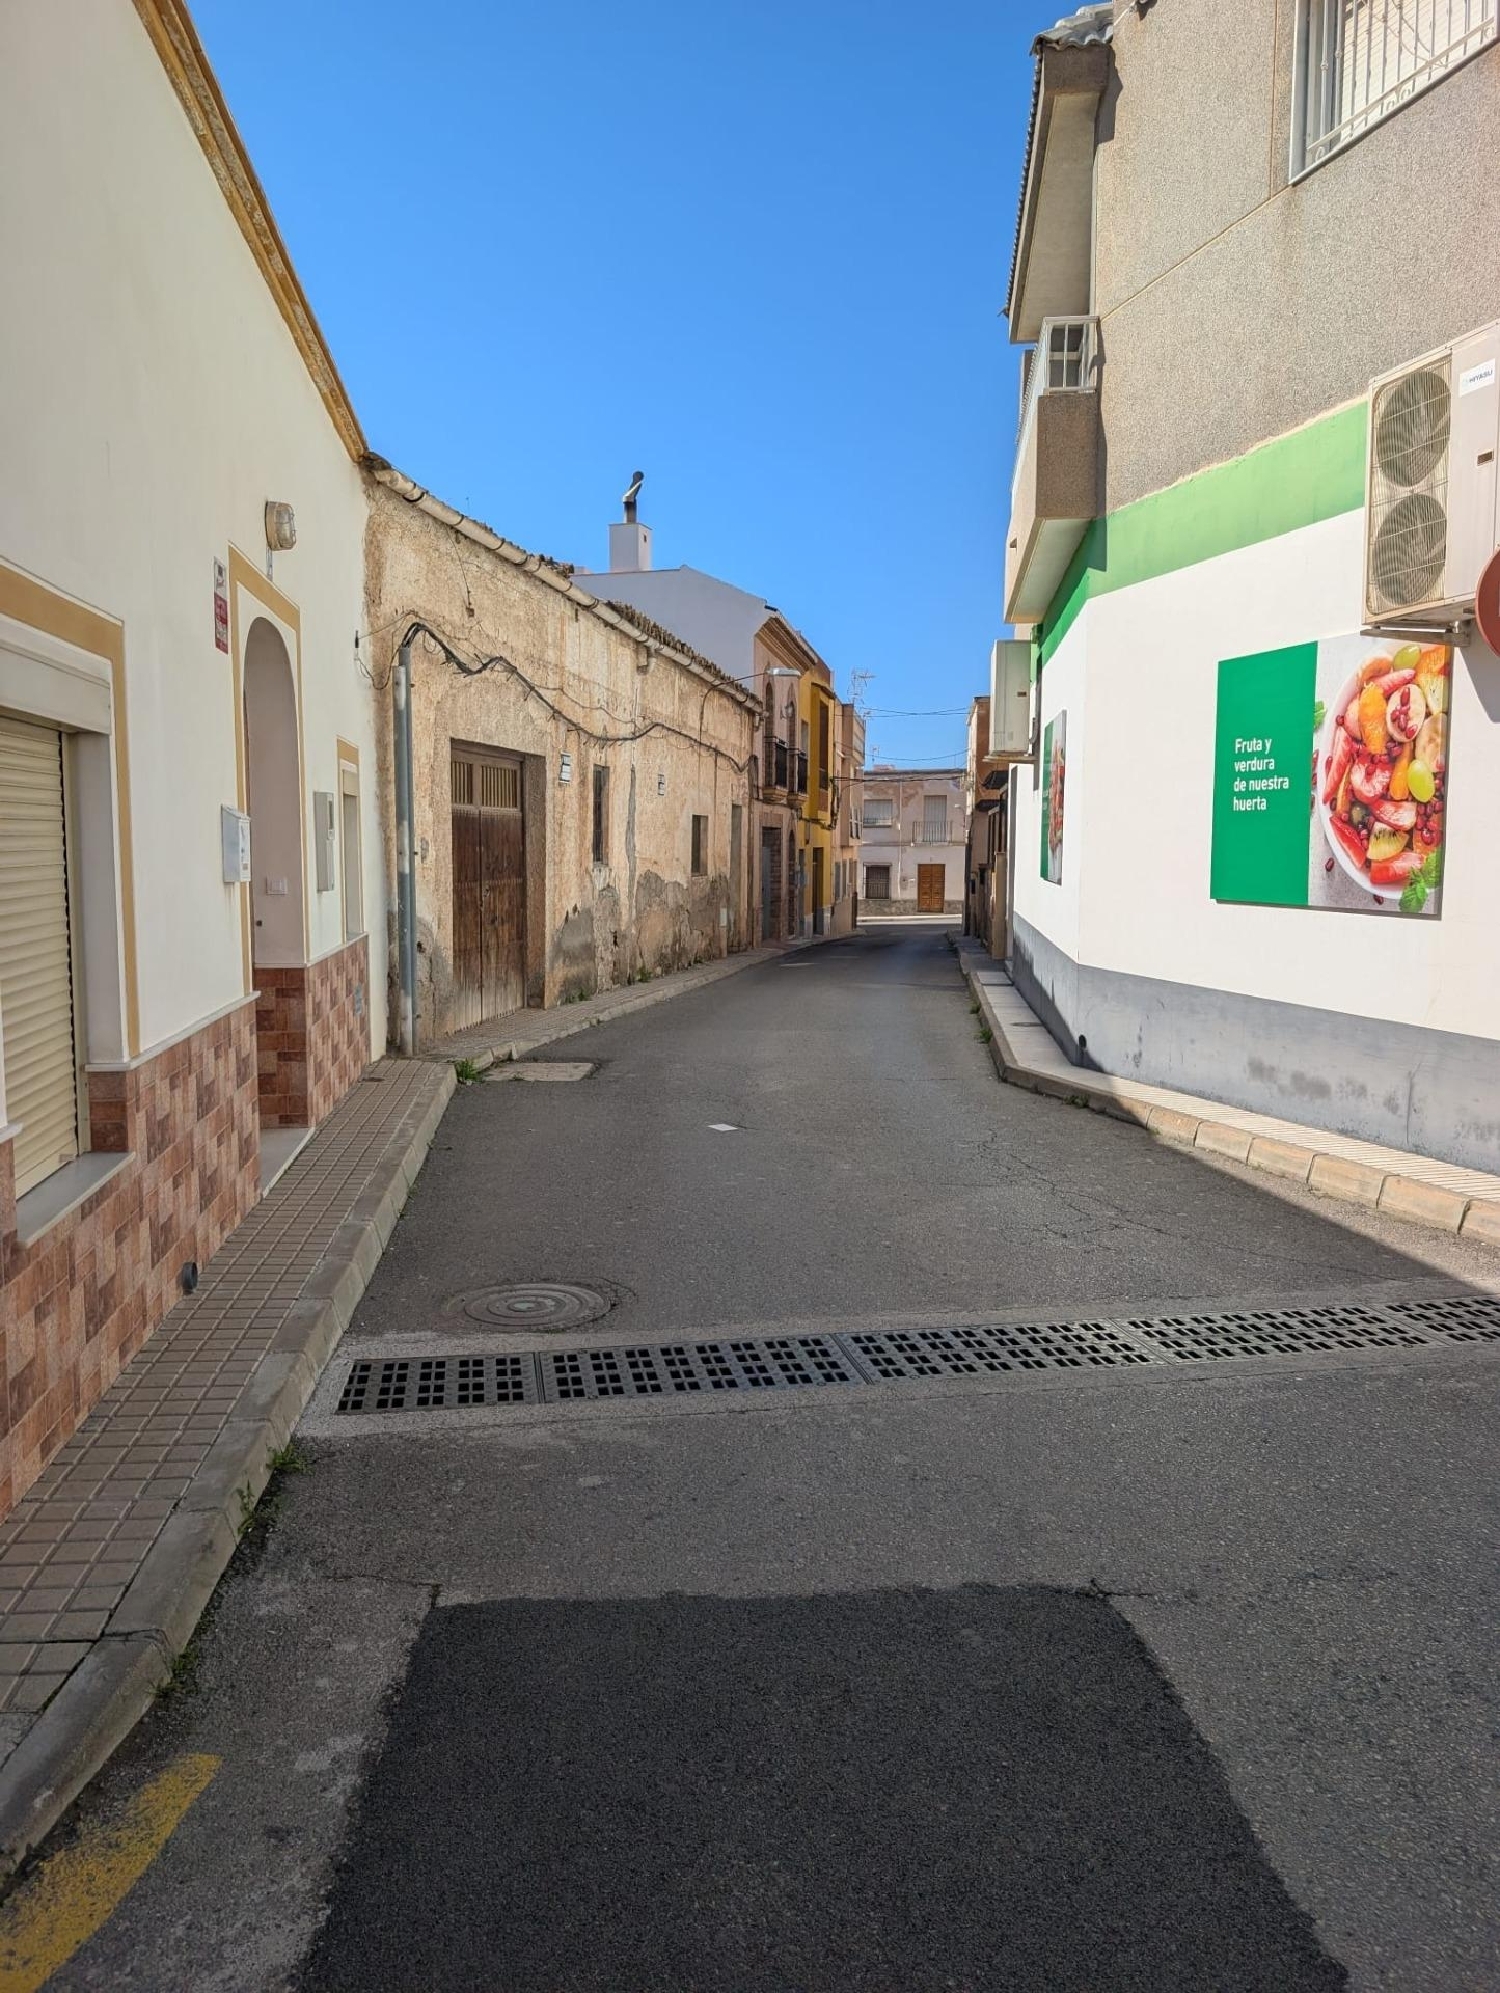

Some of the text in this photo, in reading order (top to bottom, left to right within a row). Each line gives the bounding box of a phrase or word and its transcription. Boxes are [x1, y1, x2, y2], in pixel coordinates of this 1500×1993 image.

[1235, 737, 1272, 754] Fruta y
[1234, 756, 1275, 772] verdura
[1233, 775, 1289, 792] de nuestra
[1233, 796, 1267, 811] huerta
